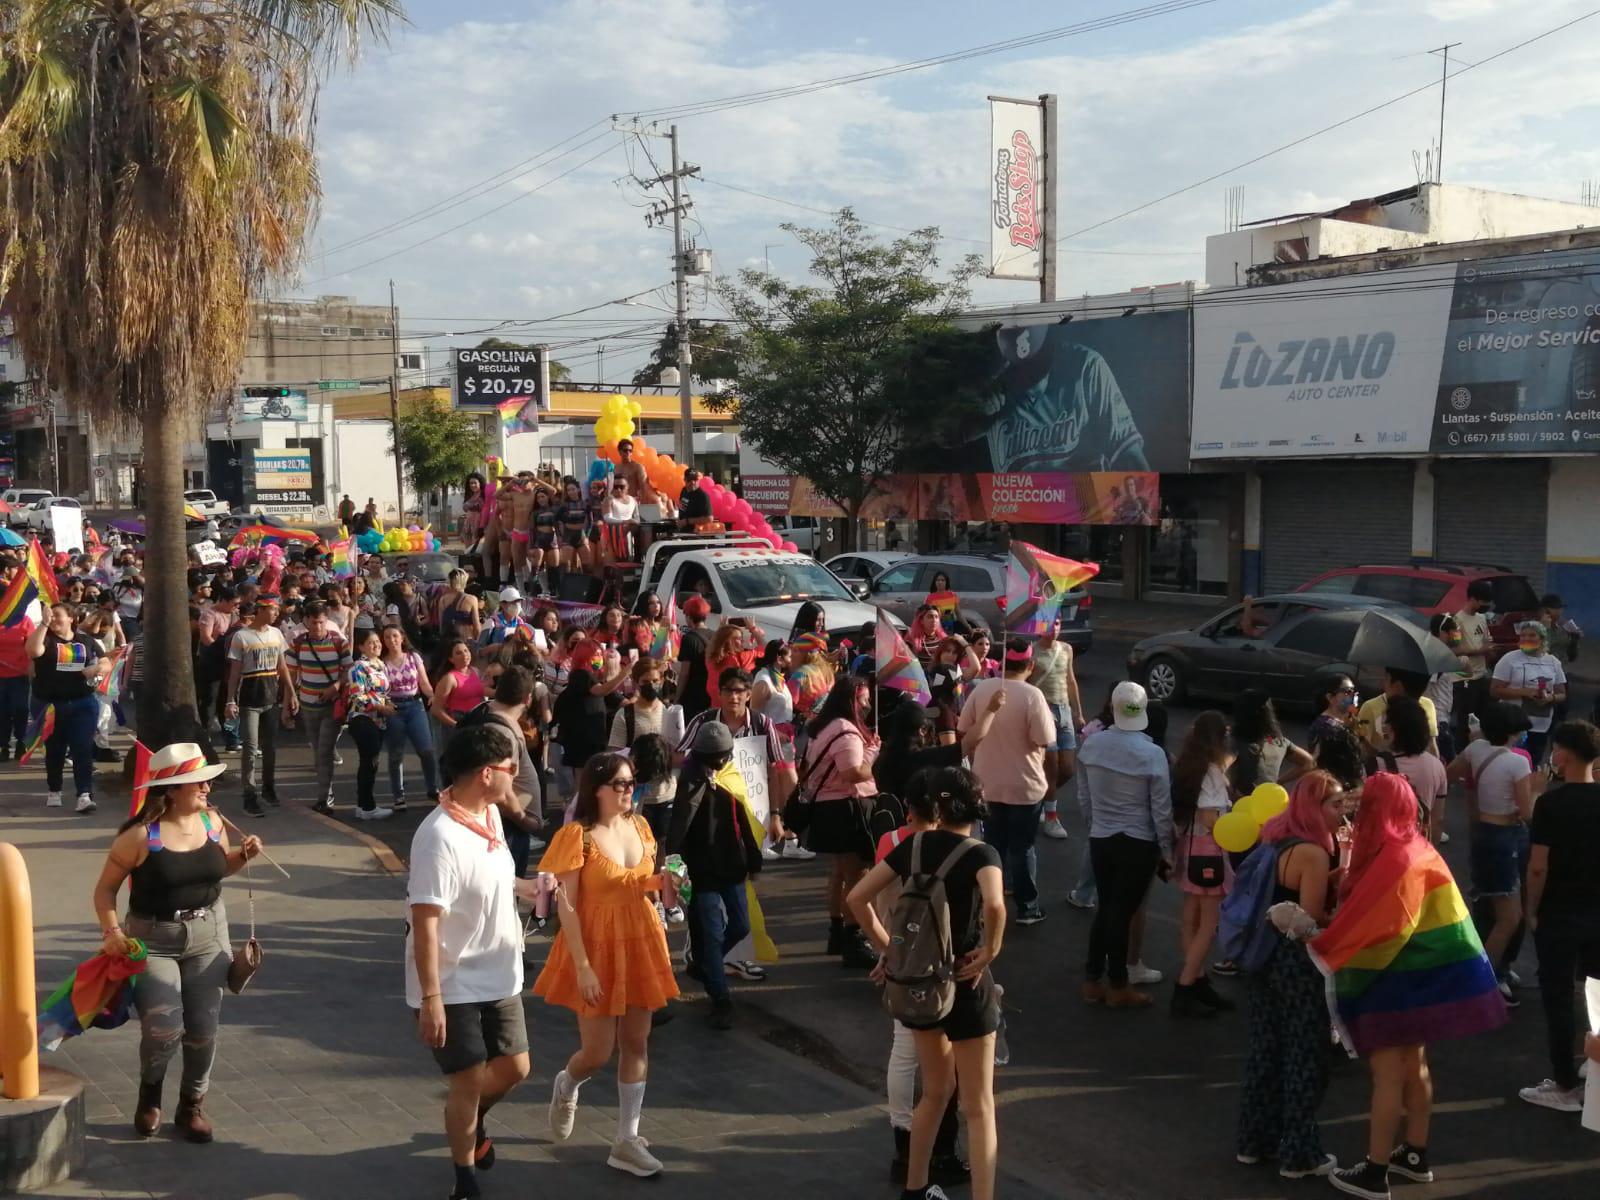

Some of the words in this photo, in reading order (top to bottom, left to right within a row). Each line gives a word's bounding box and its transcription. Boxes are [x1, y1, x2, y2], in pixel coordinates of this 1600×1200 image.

[1485, 309, 1508, 325] De
[1513, 305, 1578, 323] regreso
[1457, 337, 1471, 351] el
[1477, 331, 1533, 352] Mejor
[1537, 325, 1600, 347] Servic
[459, 350, 536, 363] GASOLINA
[1219, 331, 1396, 390] LOZANO
[478, 364, 520, 373] REGULAR
[1286, 388, 1323, 401] AUTO
[1327, 384, 1380, 399] CENTER
[1442, 413, 1480, 424] Llantas
[1490, 410, 1553, 424] Suspensión
[1463, 433, 1488, 443] (667)
[1508, 432, 1530, 441] 5901
[1540, 432, 1564, 441] 5902
[778, 479, 790, 487] LOS
[992, 475, 1033, 487] NUEVA
[257, 493, 282, 501] DIESEL
[743, 490, 790, 500] DESCUENTOS
[719, 559, 769, 571] GRUAS
